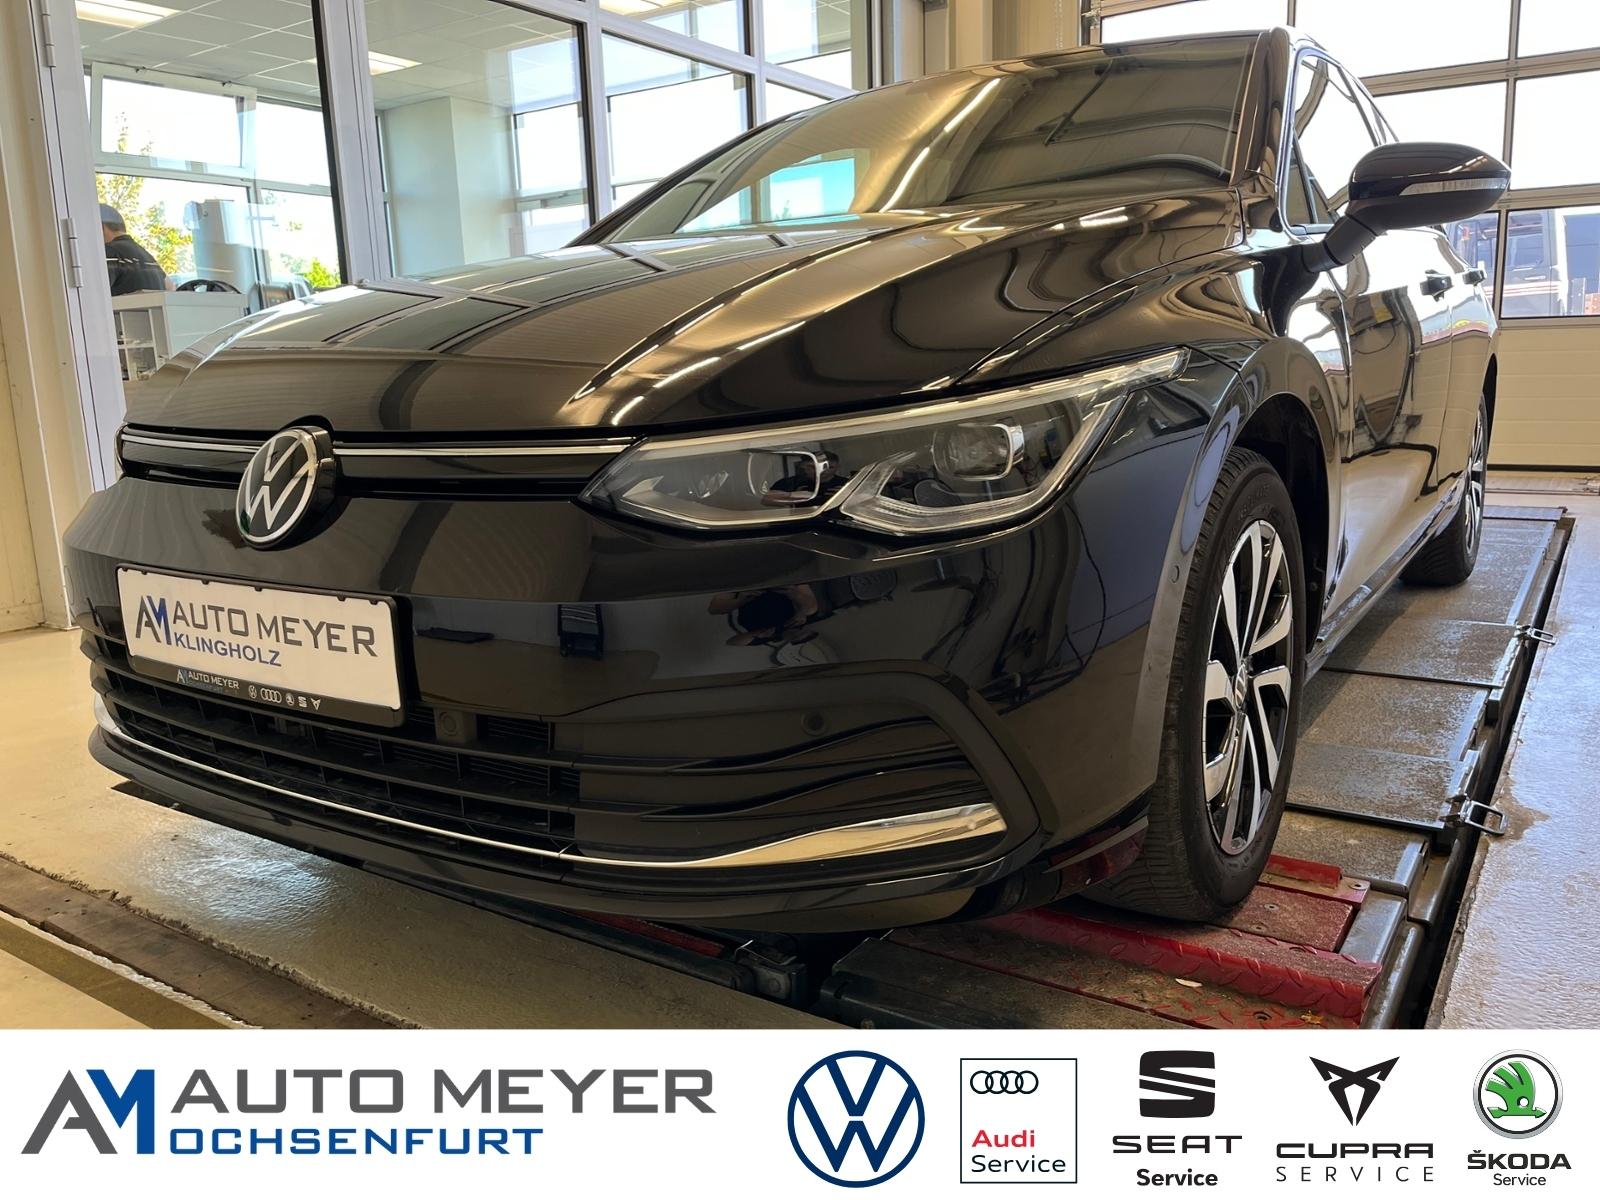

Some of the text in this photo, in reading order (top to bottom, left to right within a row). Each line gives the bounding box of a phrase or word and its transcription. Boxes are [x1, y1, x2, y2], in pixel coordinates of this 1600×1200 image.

[173, 600, 378, 658] AUTO MEYER
[173, 631, 282, 667] KLINGHOLZ
[188, 671, 210, 683] AUTO
[210, 675, 240, 690] MEYER
